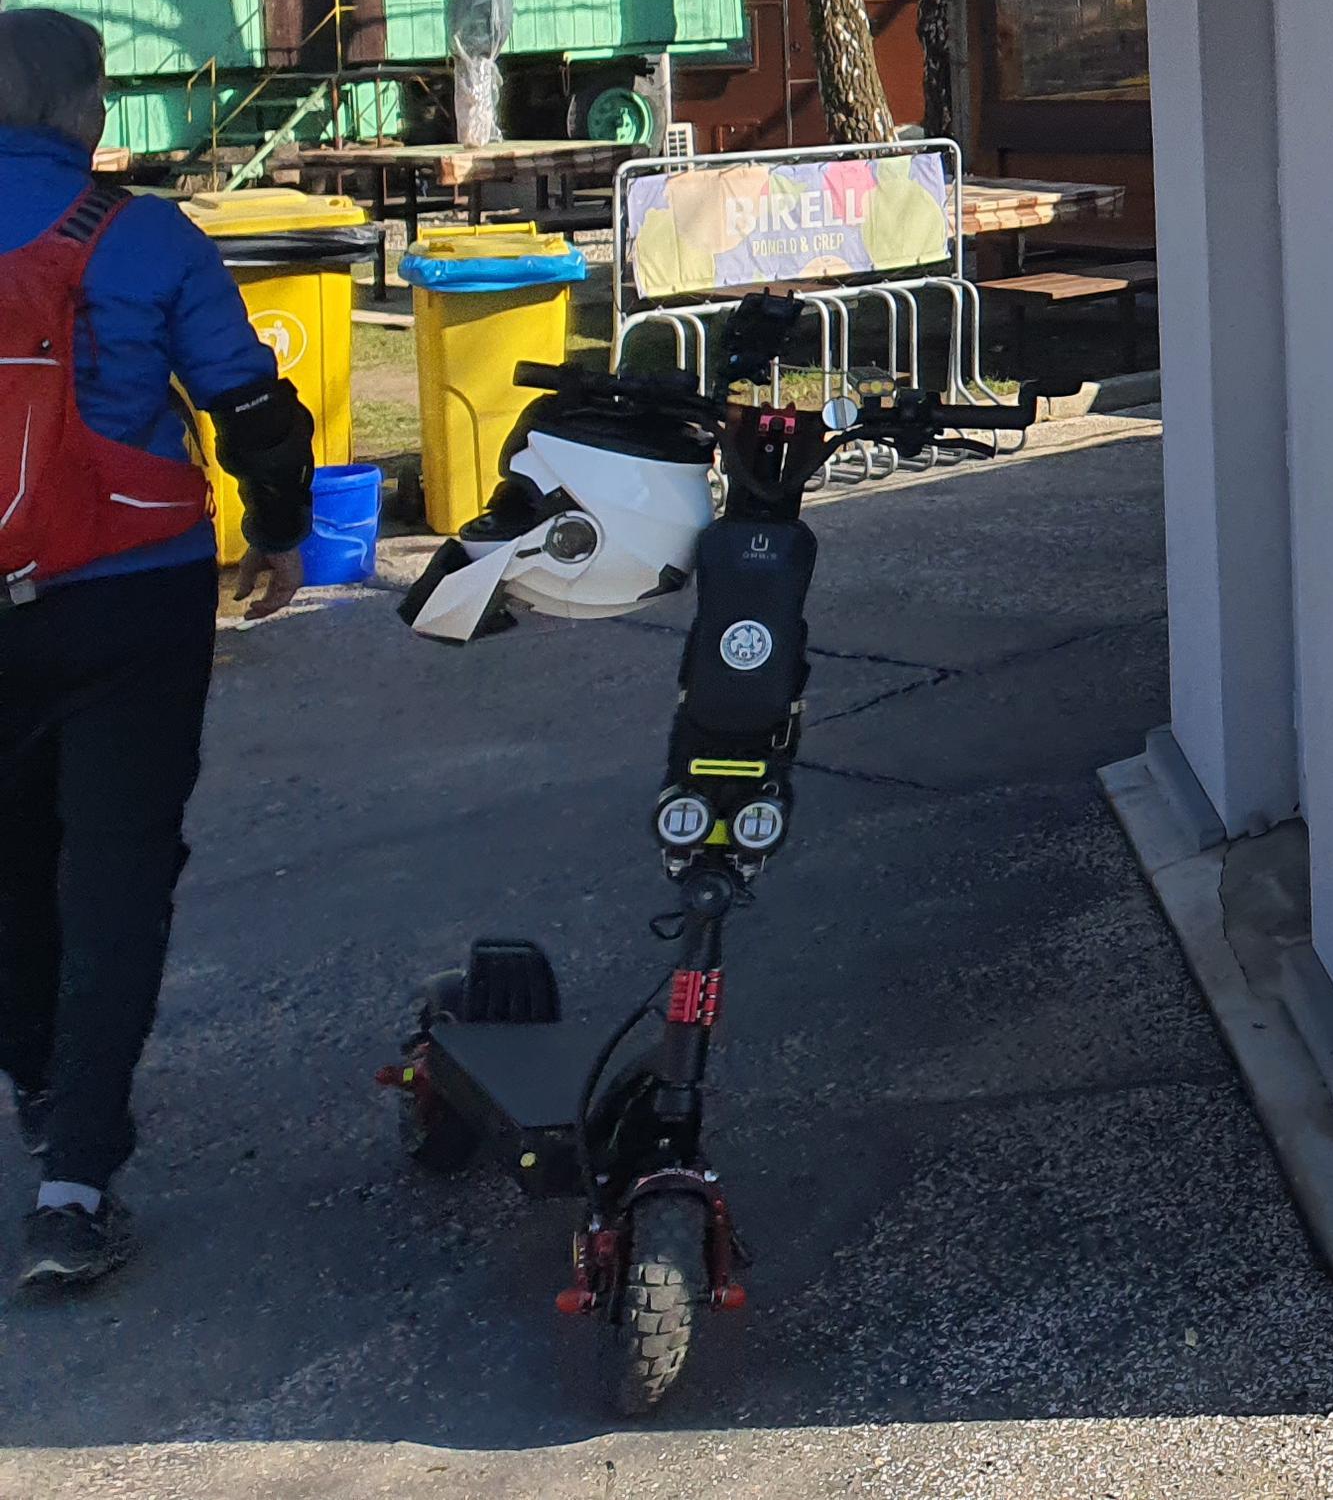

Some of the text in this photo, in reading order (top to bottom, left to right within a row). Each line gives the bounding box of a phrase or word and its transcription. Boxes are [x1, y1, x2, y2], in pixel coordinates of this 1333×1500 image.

[725, 188, 866, 237] BIRELL
[752, 232, 844, 257] POMELO & GREP
